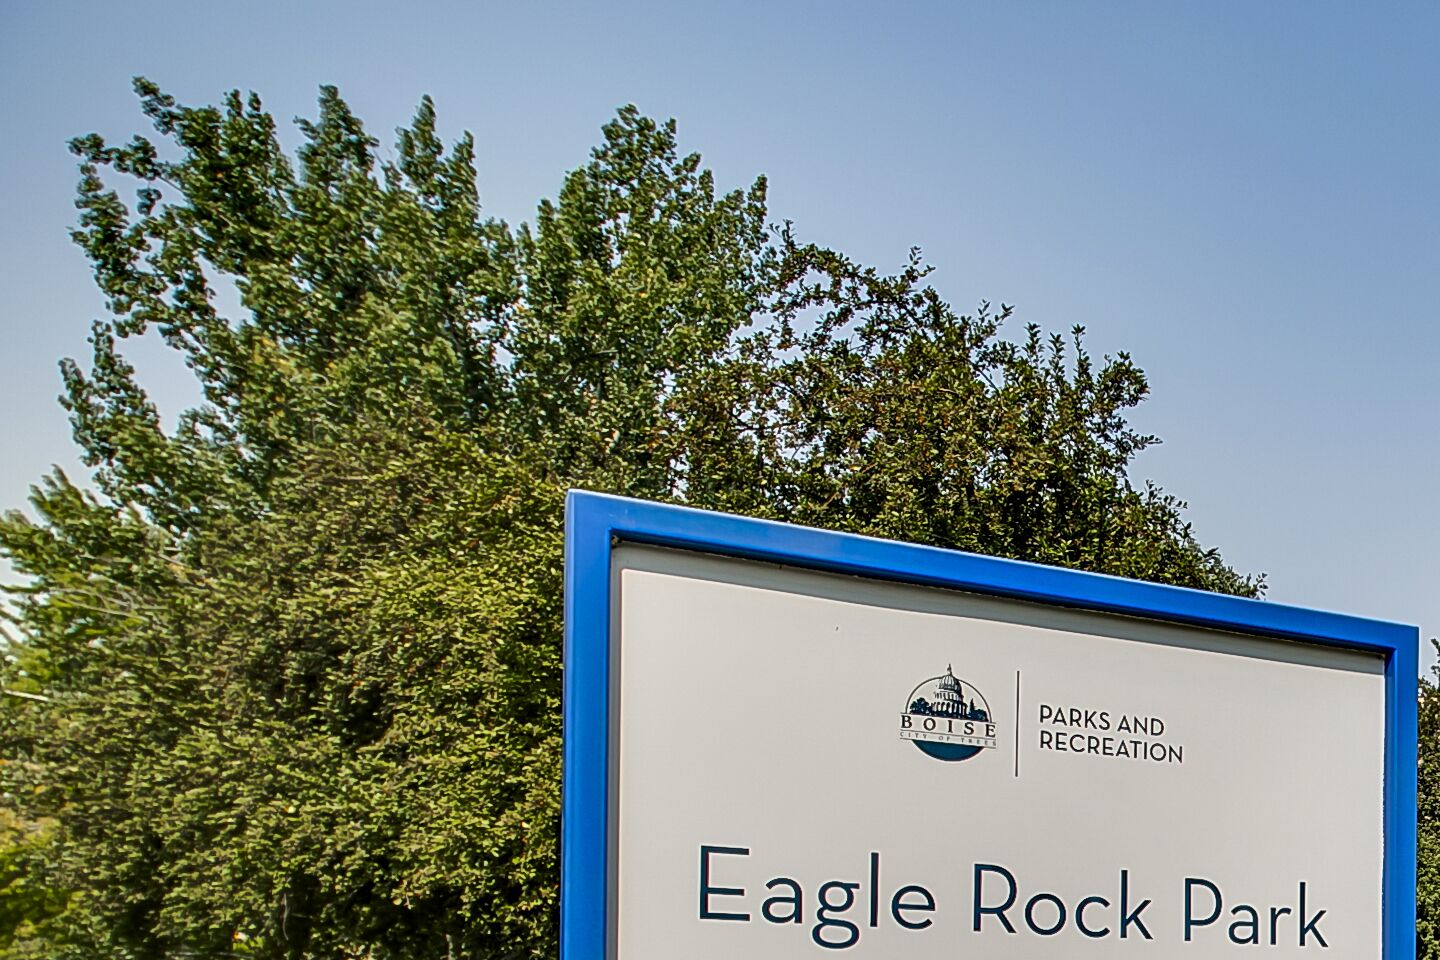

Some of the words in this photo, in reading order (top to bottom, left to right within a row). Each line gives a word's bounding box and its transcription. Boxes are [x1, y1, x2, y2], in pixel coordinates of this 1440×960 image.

[900, 714, 996, 738] BOISE
[1039, 704, 1111, 731] PARKS
[1116, 714, 1165, 737] AND
[900, 731, 927, 740] CITY
[961, 737, 996, 747] TREES
[1039, 729, 1183, 764] RECREATION
[699, 845, 936, 950] Eagle
[973, 863, 1154, 941] Rock
[1184, 877, 1329, 948] Park
